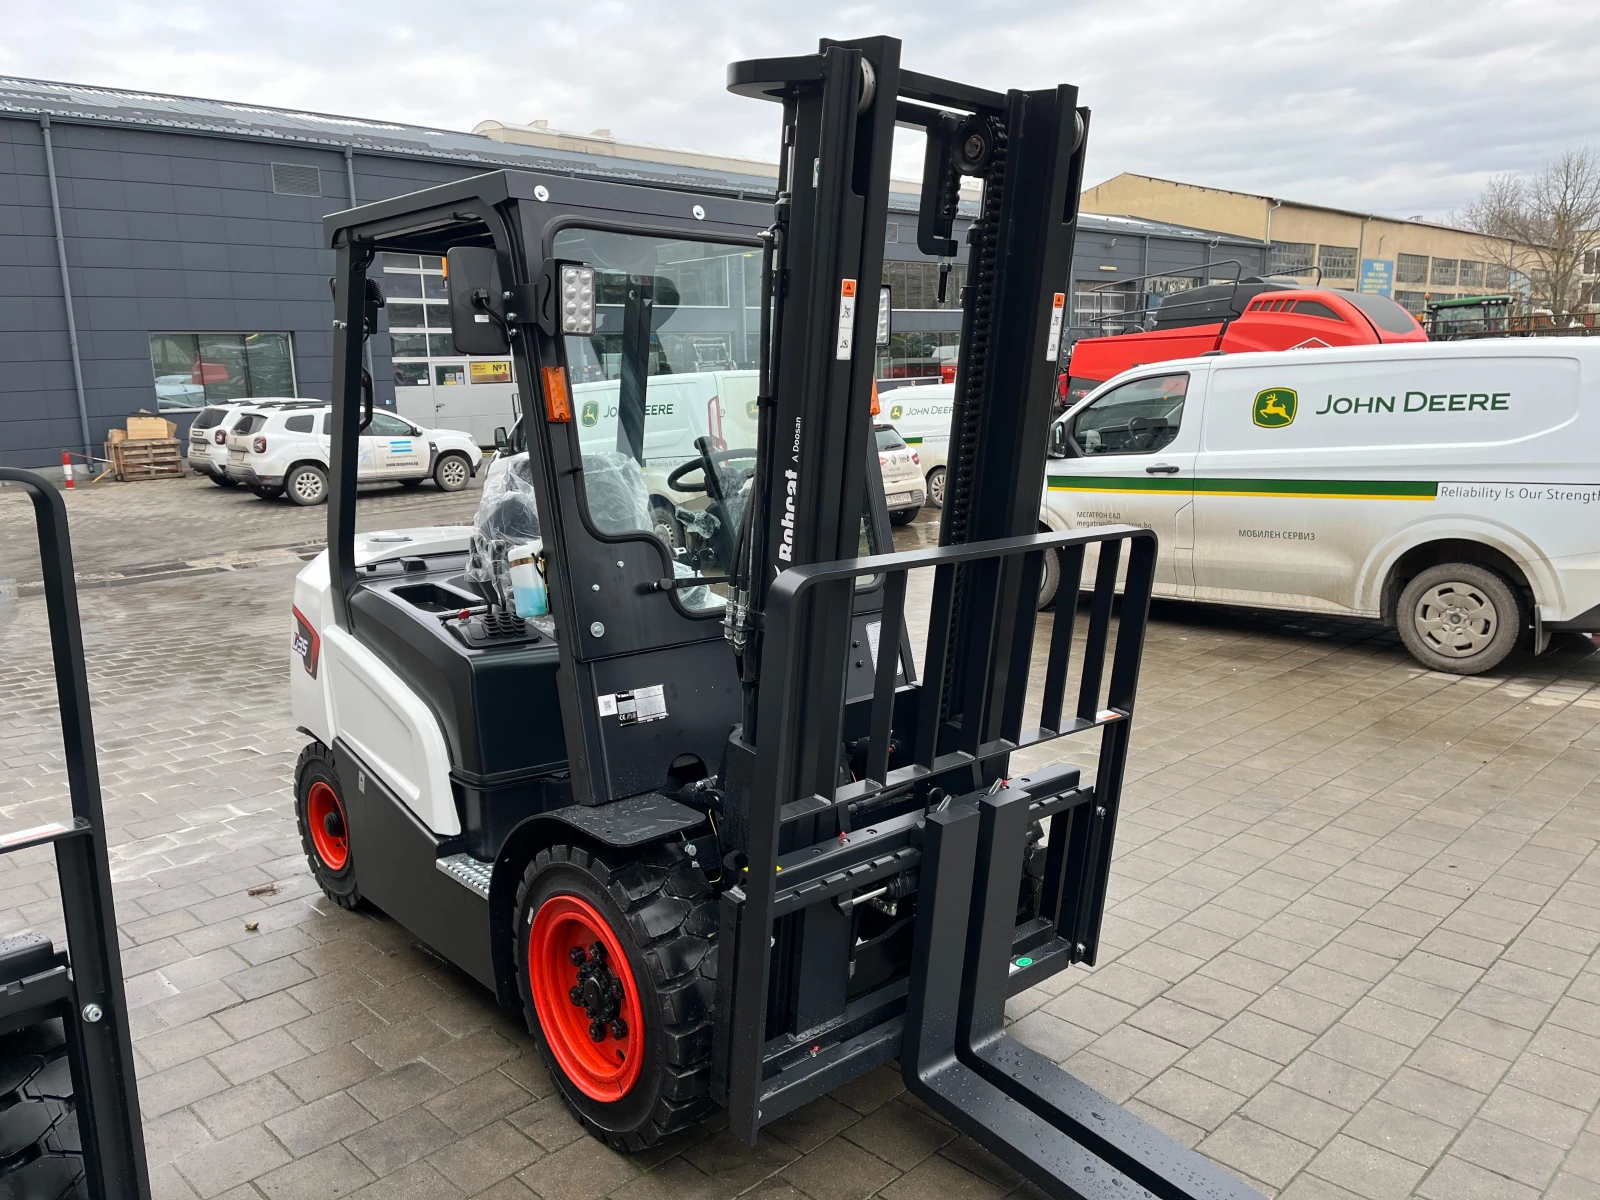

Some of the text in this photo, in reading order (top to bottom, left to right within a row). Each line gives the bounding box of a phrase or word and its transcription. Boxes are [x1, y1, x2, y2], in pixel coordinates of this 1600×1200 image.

[1315, 391, 1511, 415] JOHN DEERE
[603, 404, 674, 418] JO EERE
[905, 405, 954, 416] JOHN DEER
[792, 416, 802, 463] A Doosan
[1441, 486, 1501, 501] Reliability
[1505, 487, 1515, 499] Is
[1519, 487, 1543, 500] Our
[1076, 511, 1121, 520] МЕГАТРОН ЕАД
[1238, 529, 1316, 541] МОБИЛЕН СЕРВИЗ
